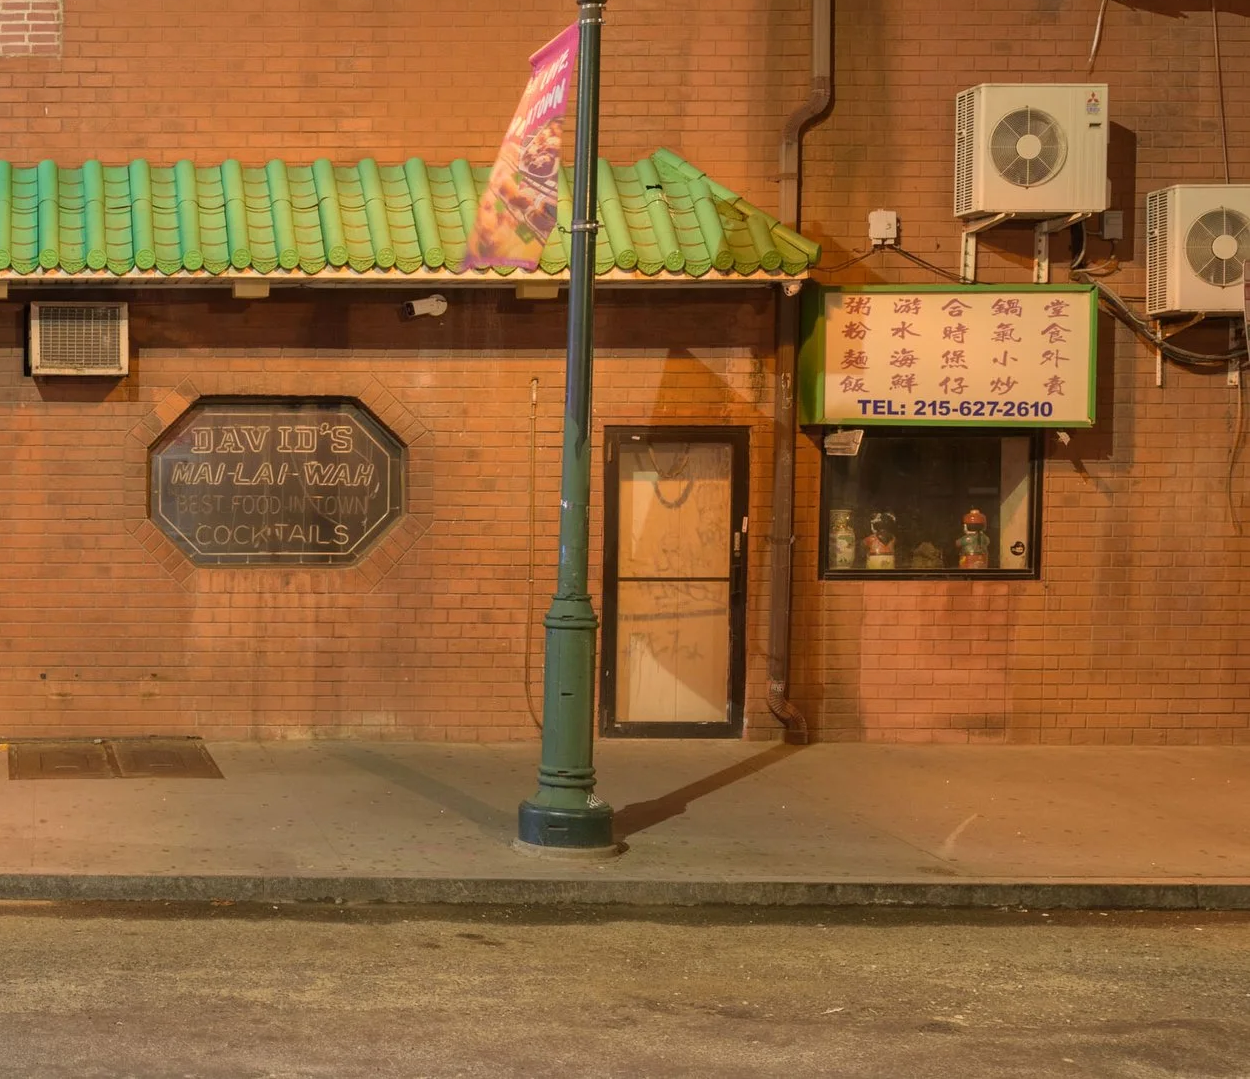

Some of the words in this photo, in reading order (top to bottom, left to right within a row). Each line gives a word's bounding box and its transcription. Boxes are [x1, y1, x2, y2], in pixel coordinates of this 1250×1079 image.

[857, 399, 906, 416] TEL:
[914, 400, 1053, 418] 215-627-2610
[190, 423, 353, 454] DAVID'S
[195, 523, 350, 546] COCKTAILS
